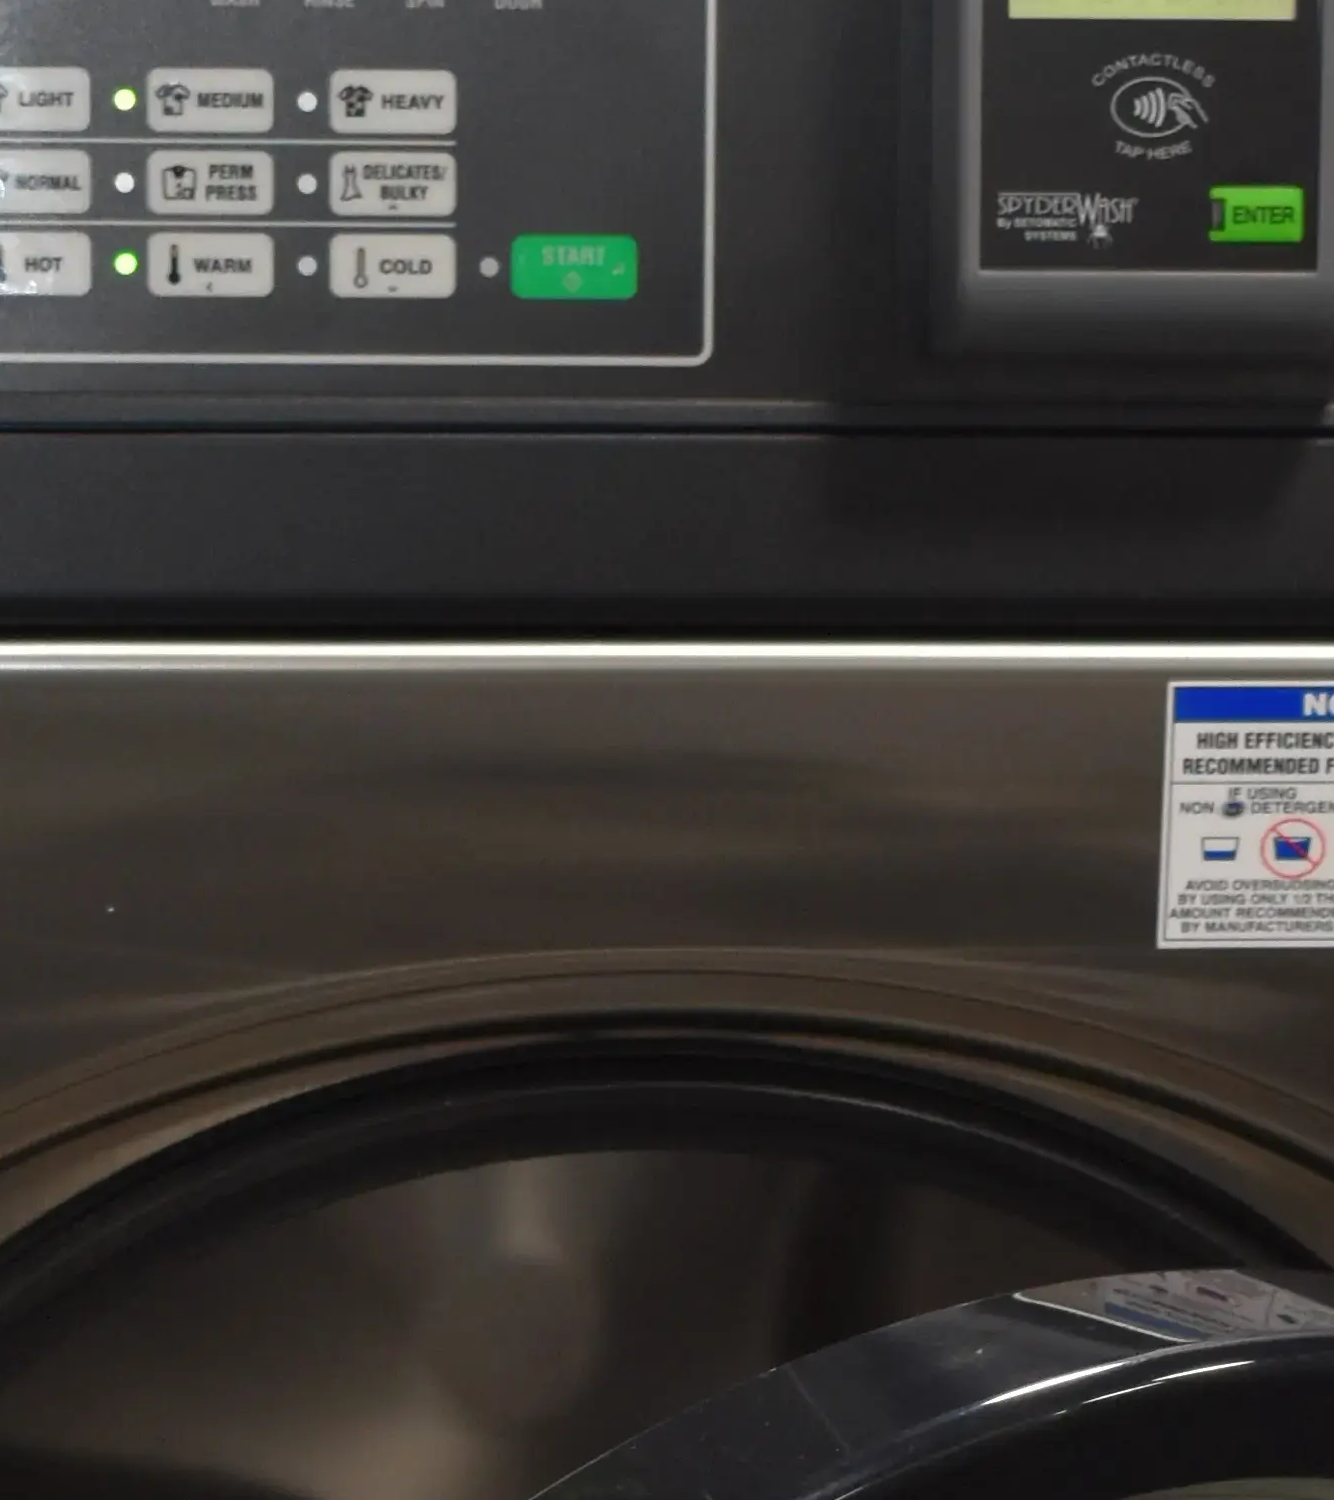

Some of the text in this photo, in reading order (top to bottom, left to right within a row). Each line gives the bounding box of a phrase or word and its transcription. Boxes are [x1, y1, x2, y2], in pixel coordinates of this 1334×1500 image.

[1092, 53, 1216, 87] CONTACTLESS
[19, 91, 74, 107] LIGHT
[197, 93, 263, 108] MEDIUM
[381, 93, 444, 110] HEAVY
[1115, 140, 1192, 160] TAP HERE
[209, 164, 253, 179] PERM
[16, 175, 82, 191] NORMAL
[206, 185, 257, 201] PRESS
[380, 185, 428, 200] BULKY
[1232, 206, 1294, 225] ENTER
[542, 246, 606, 266] START
[25, 257, 63, 272] HOT
[194, 258, 252, 273] WARM
[379, 259, 432, 275] COLD
[1197, 732, 1238, 749] HIGH
[1183, 758, 1320, 774] RECOMMENDED
[1226, 787, 1300, 801] IF USING
[1180, 802, 1214, 814] NON
